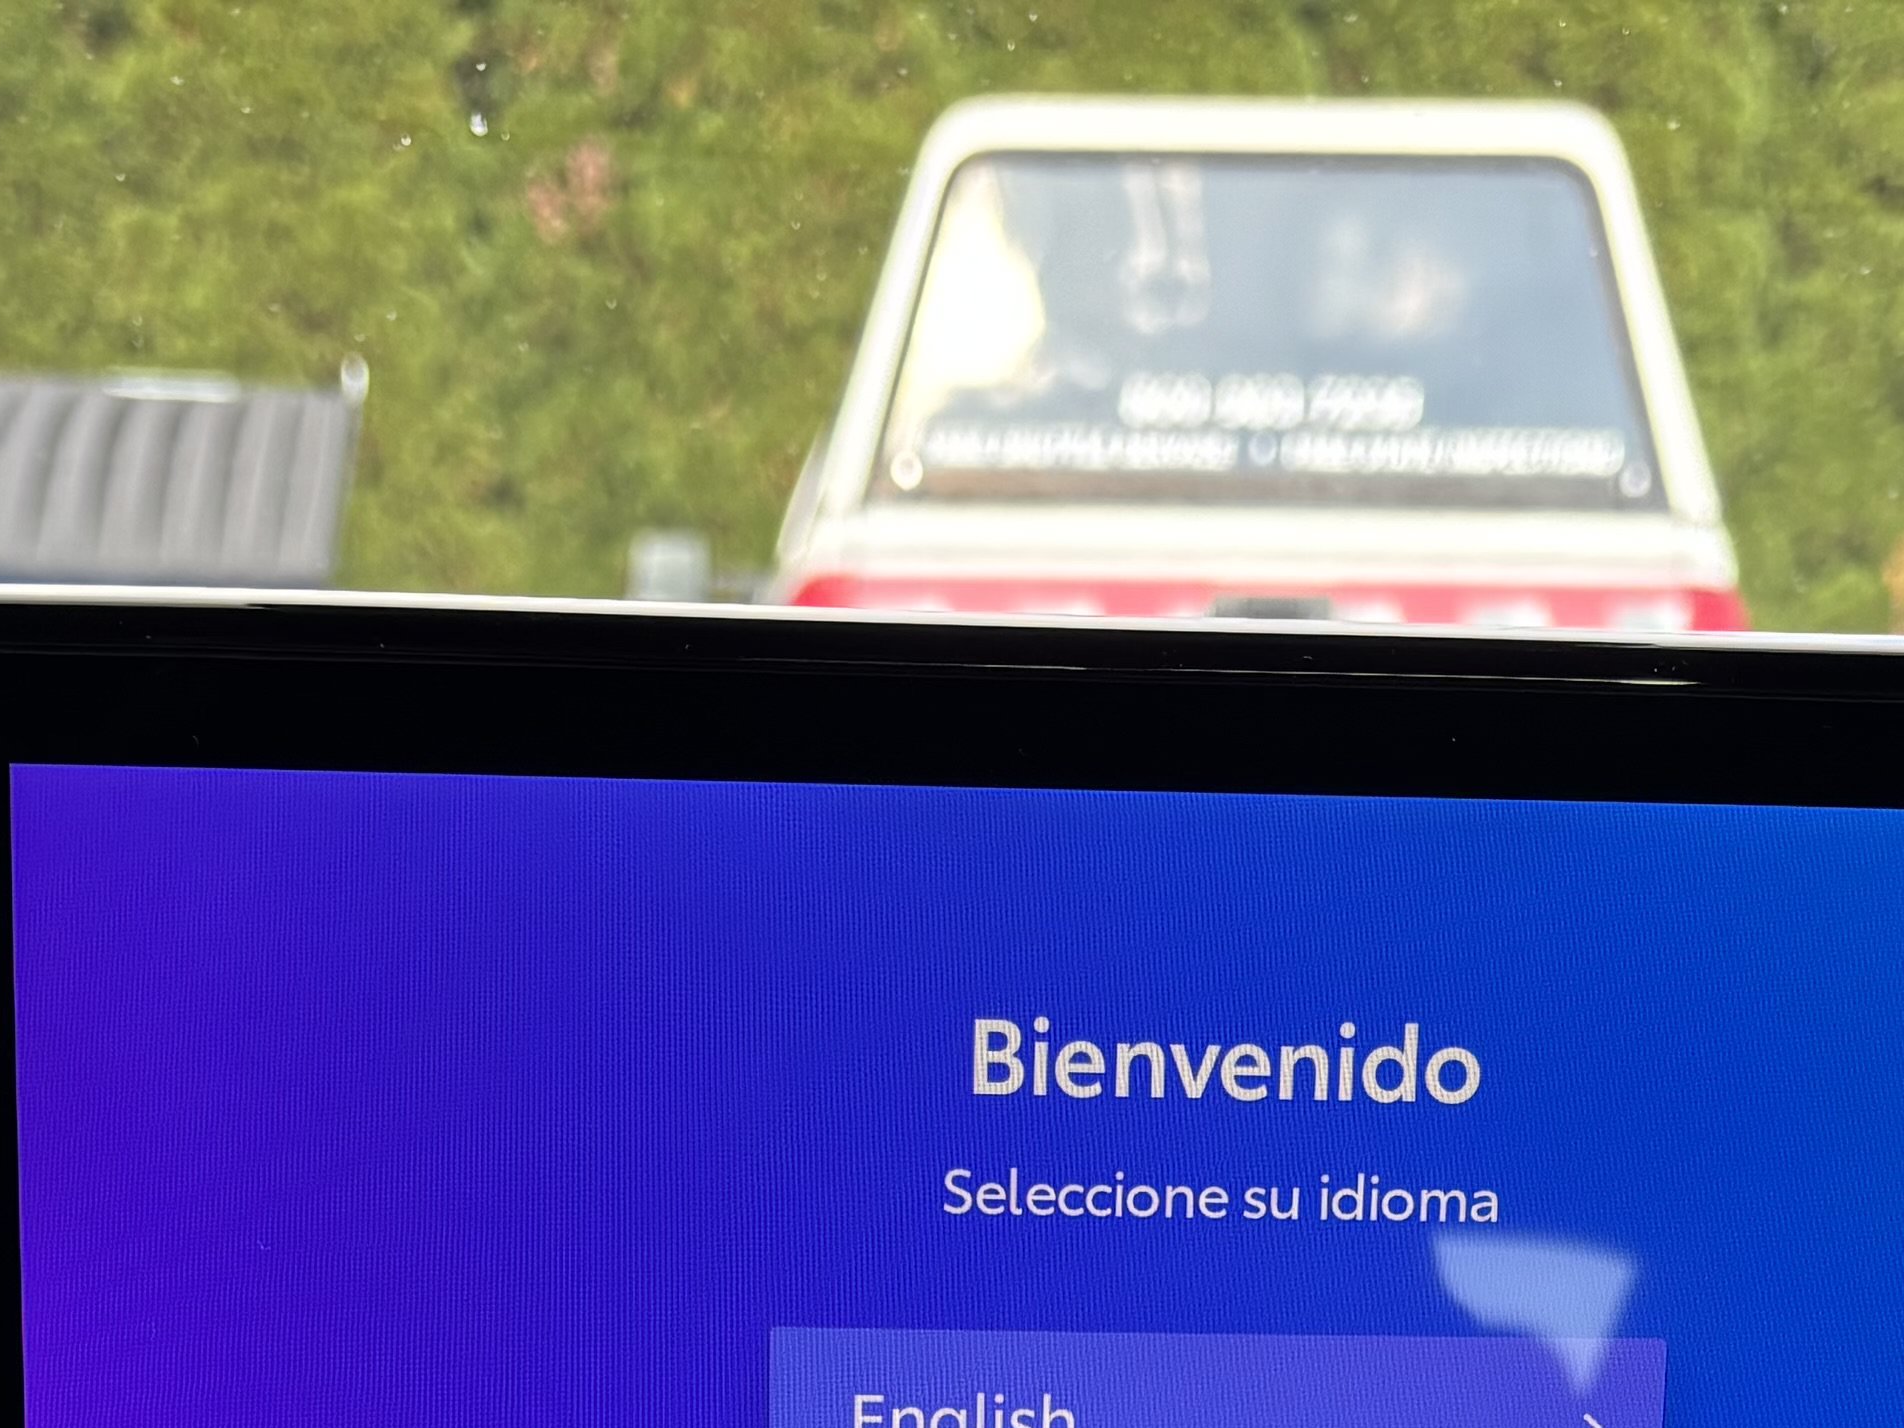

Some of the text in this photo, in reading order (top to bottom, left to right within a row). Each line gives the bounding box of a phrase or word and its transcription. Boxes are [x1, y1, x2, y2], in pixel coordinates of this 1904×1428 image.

[973, 1016, 1481, 1105] Bienvenido
[943, 1167, 1498, 1223] Seleccione su idioma
